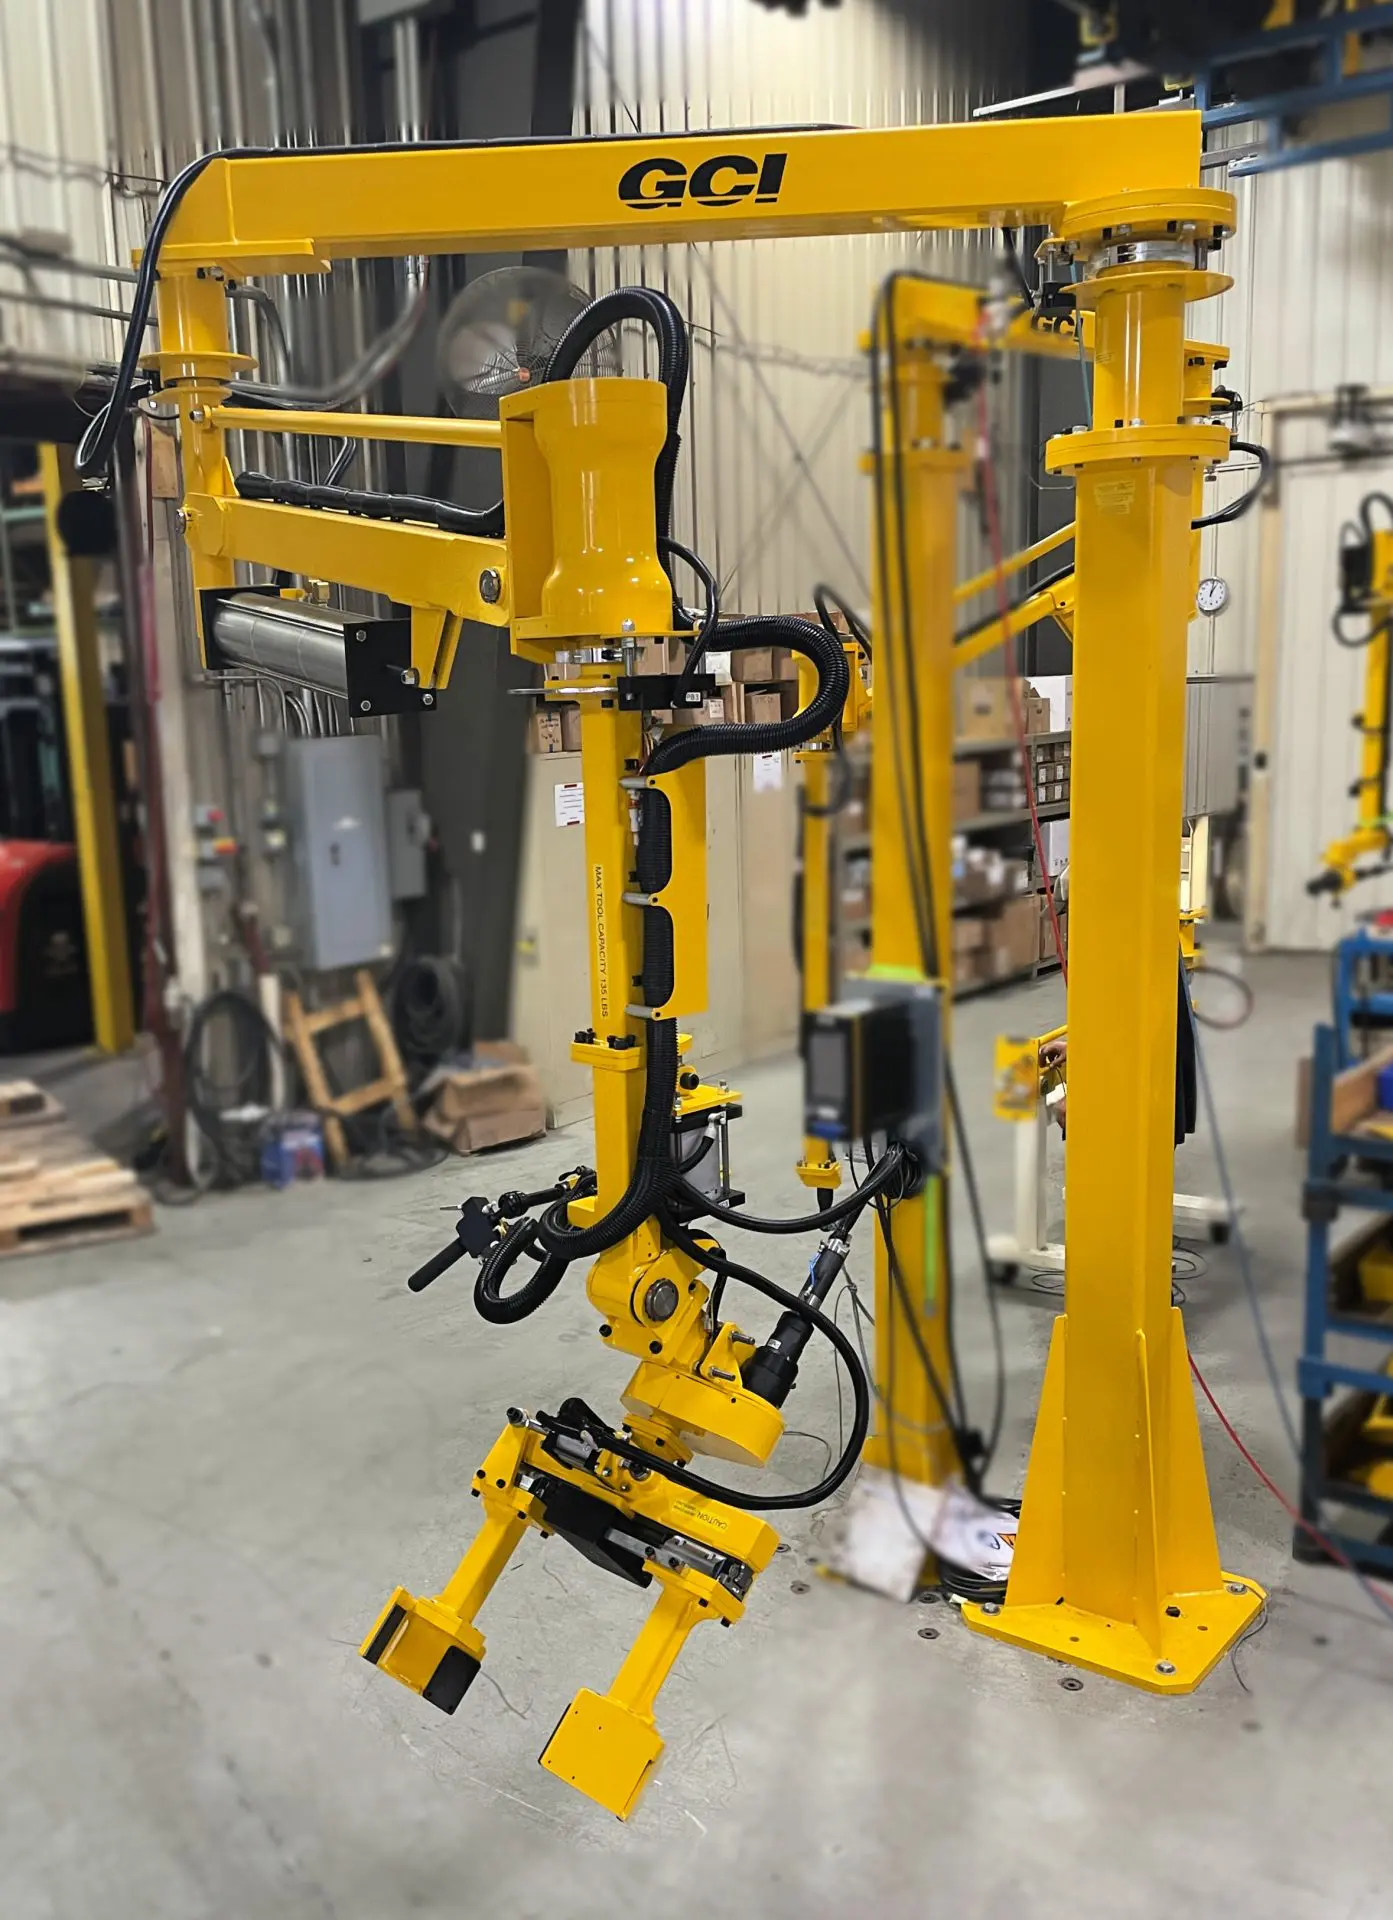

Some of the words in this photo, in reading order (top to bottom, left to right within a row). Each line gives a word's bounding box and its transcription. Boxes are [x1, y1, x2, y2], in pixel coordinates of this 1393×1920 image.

[618, 153, 788, 210] GCI
[1031, 314, 1083, 342] GCI
[596, 893, 604, 919] TOOL
[597, 923, 607, 974] CAPACITY
[600, 978, 608, 995] 135
[601, 999, 609, 1017] LBS
[697, 1512, 727, 1529] CAUTION
